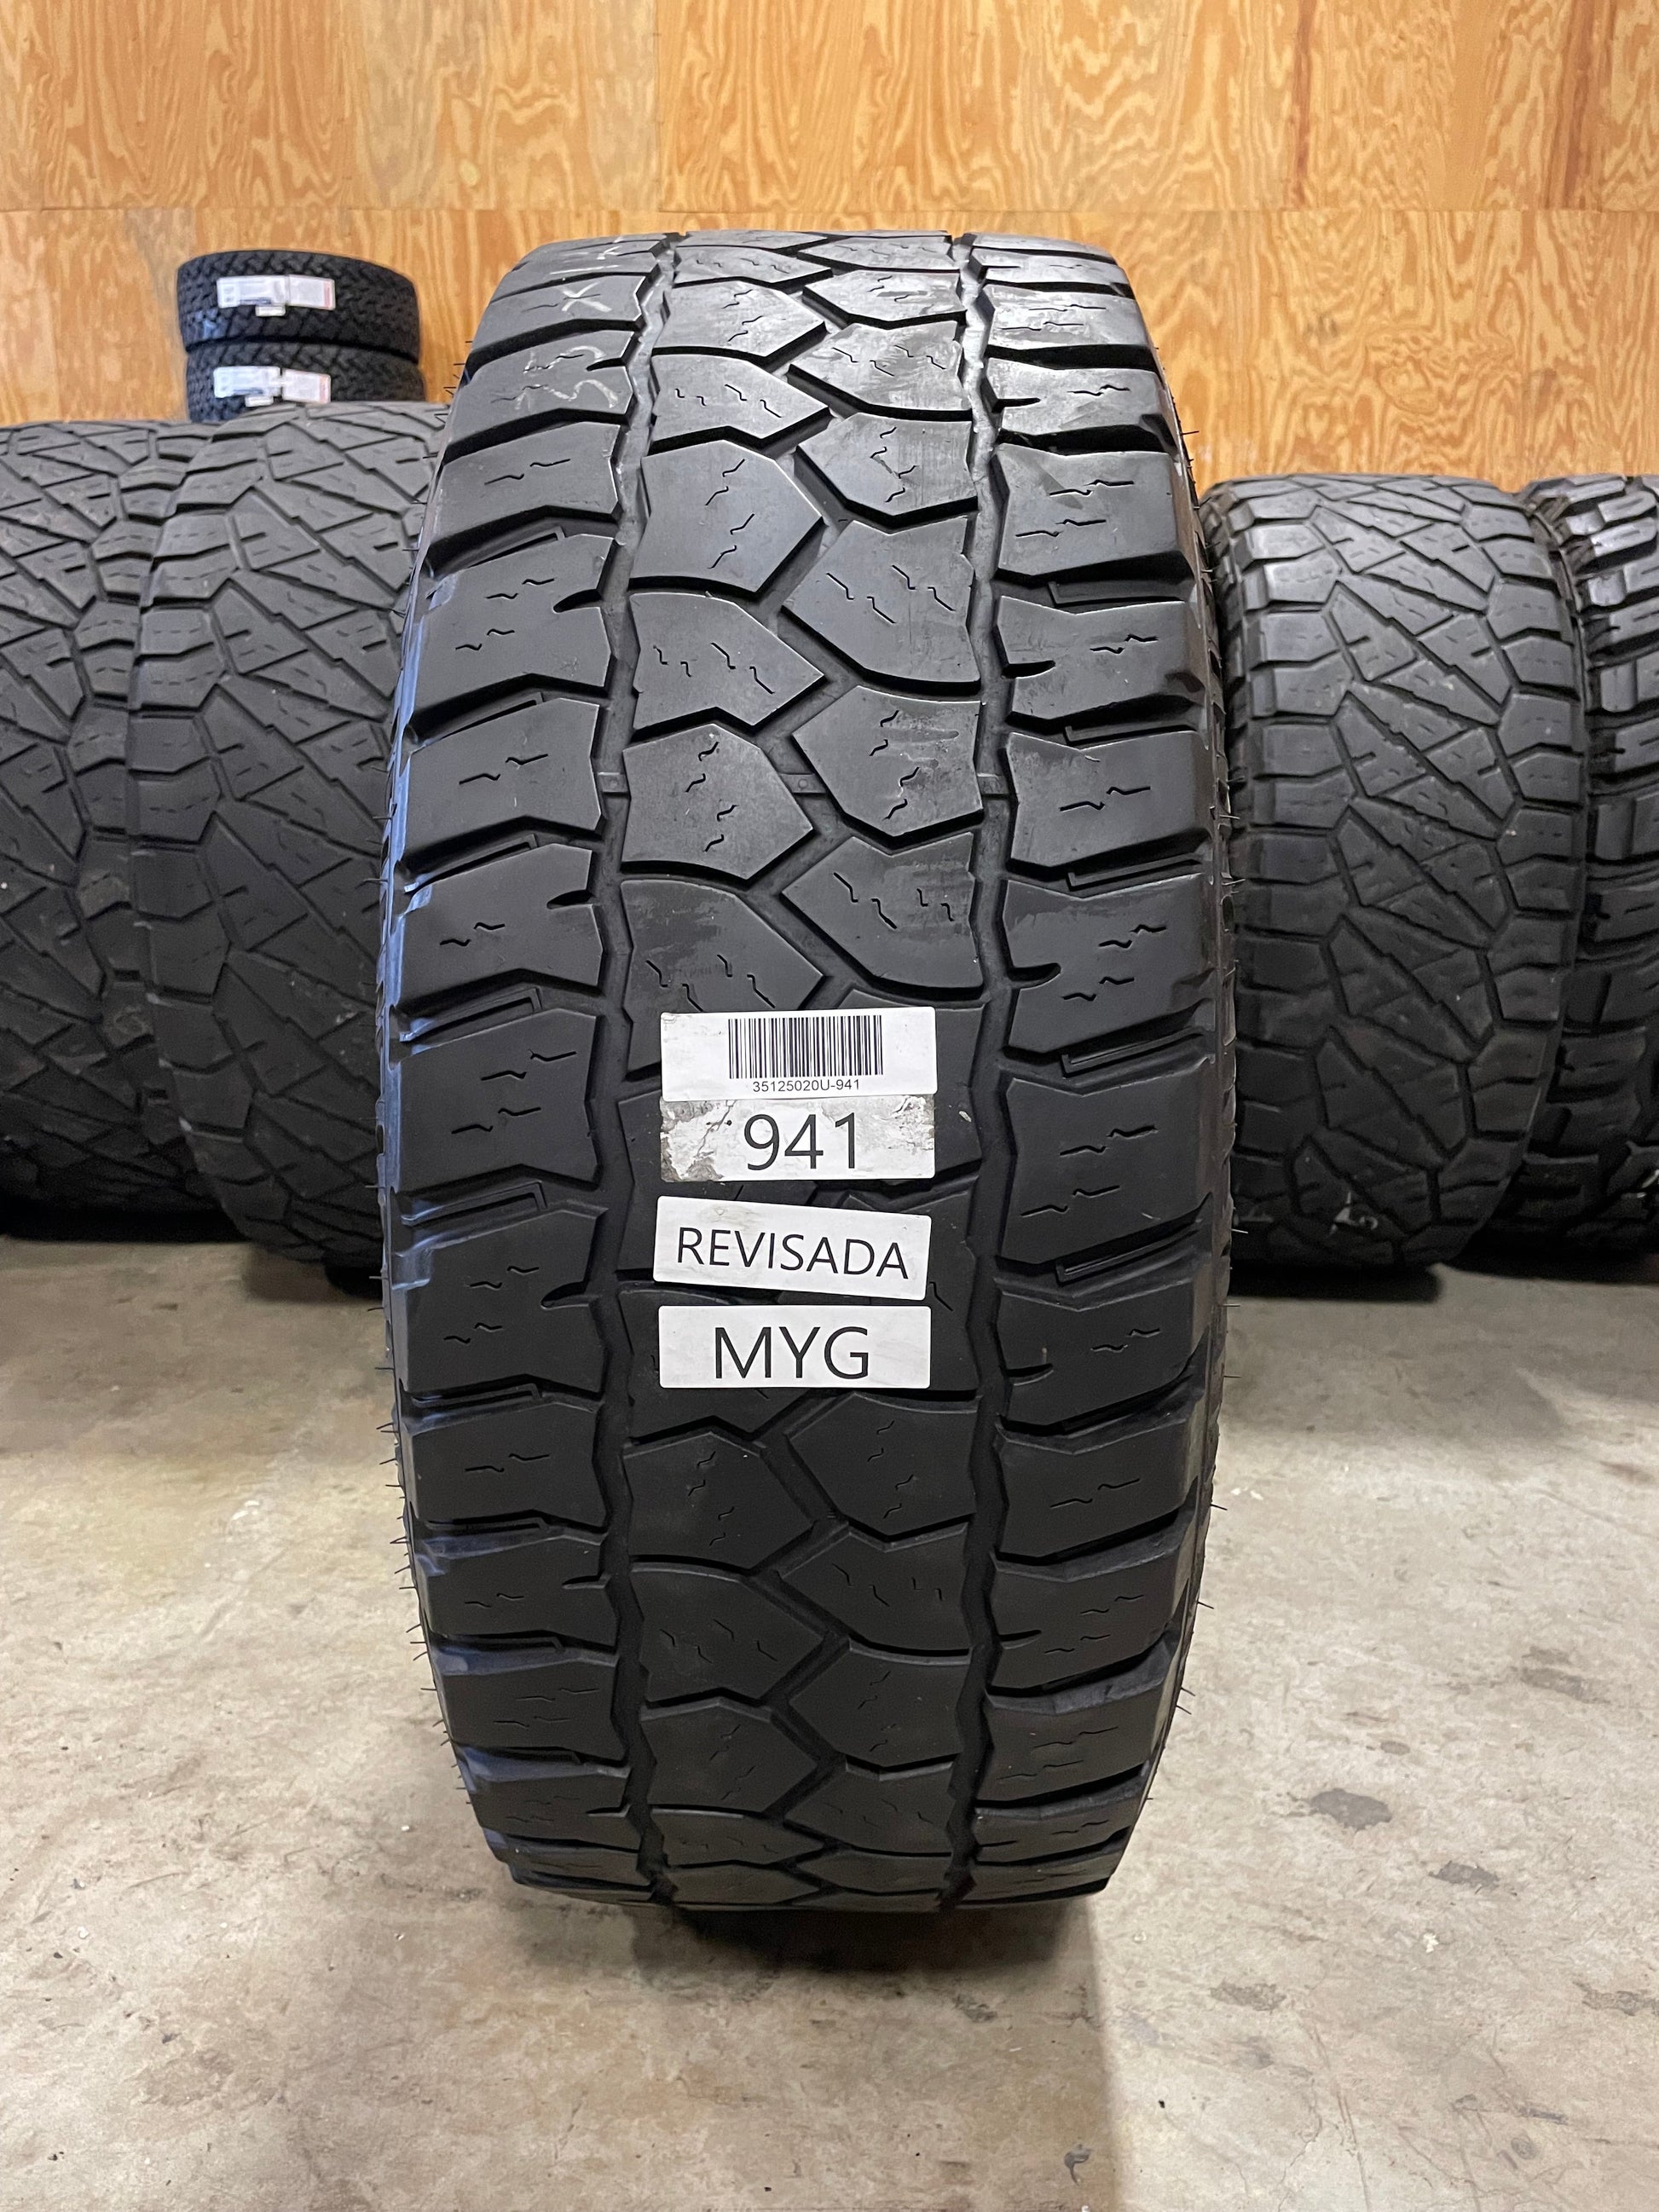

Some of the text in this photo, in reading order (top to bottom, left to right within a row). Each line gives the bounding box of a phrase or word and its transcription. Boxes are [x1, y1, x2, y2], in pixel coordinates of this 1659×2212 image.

[752, 1078, 860, 1092] 35125020U-941
[743, 1112, 857, 1171] 941
[677, 1227, 909, 1279] REVISADA
[714, 1326, 870, 1379] MYG
